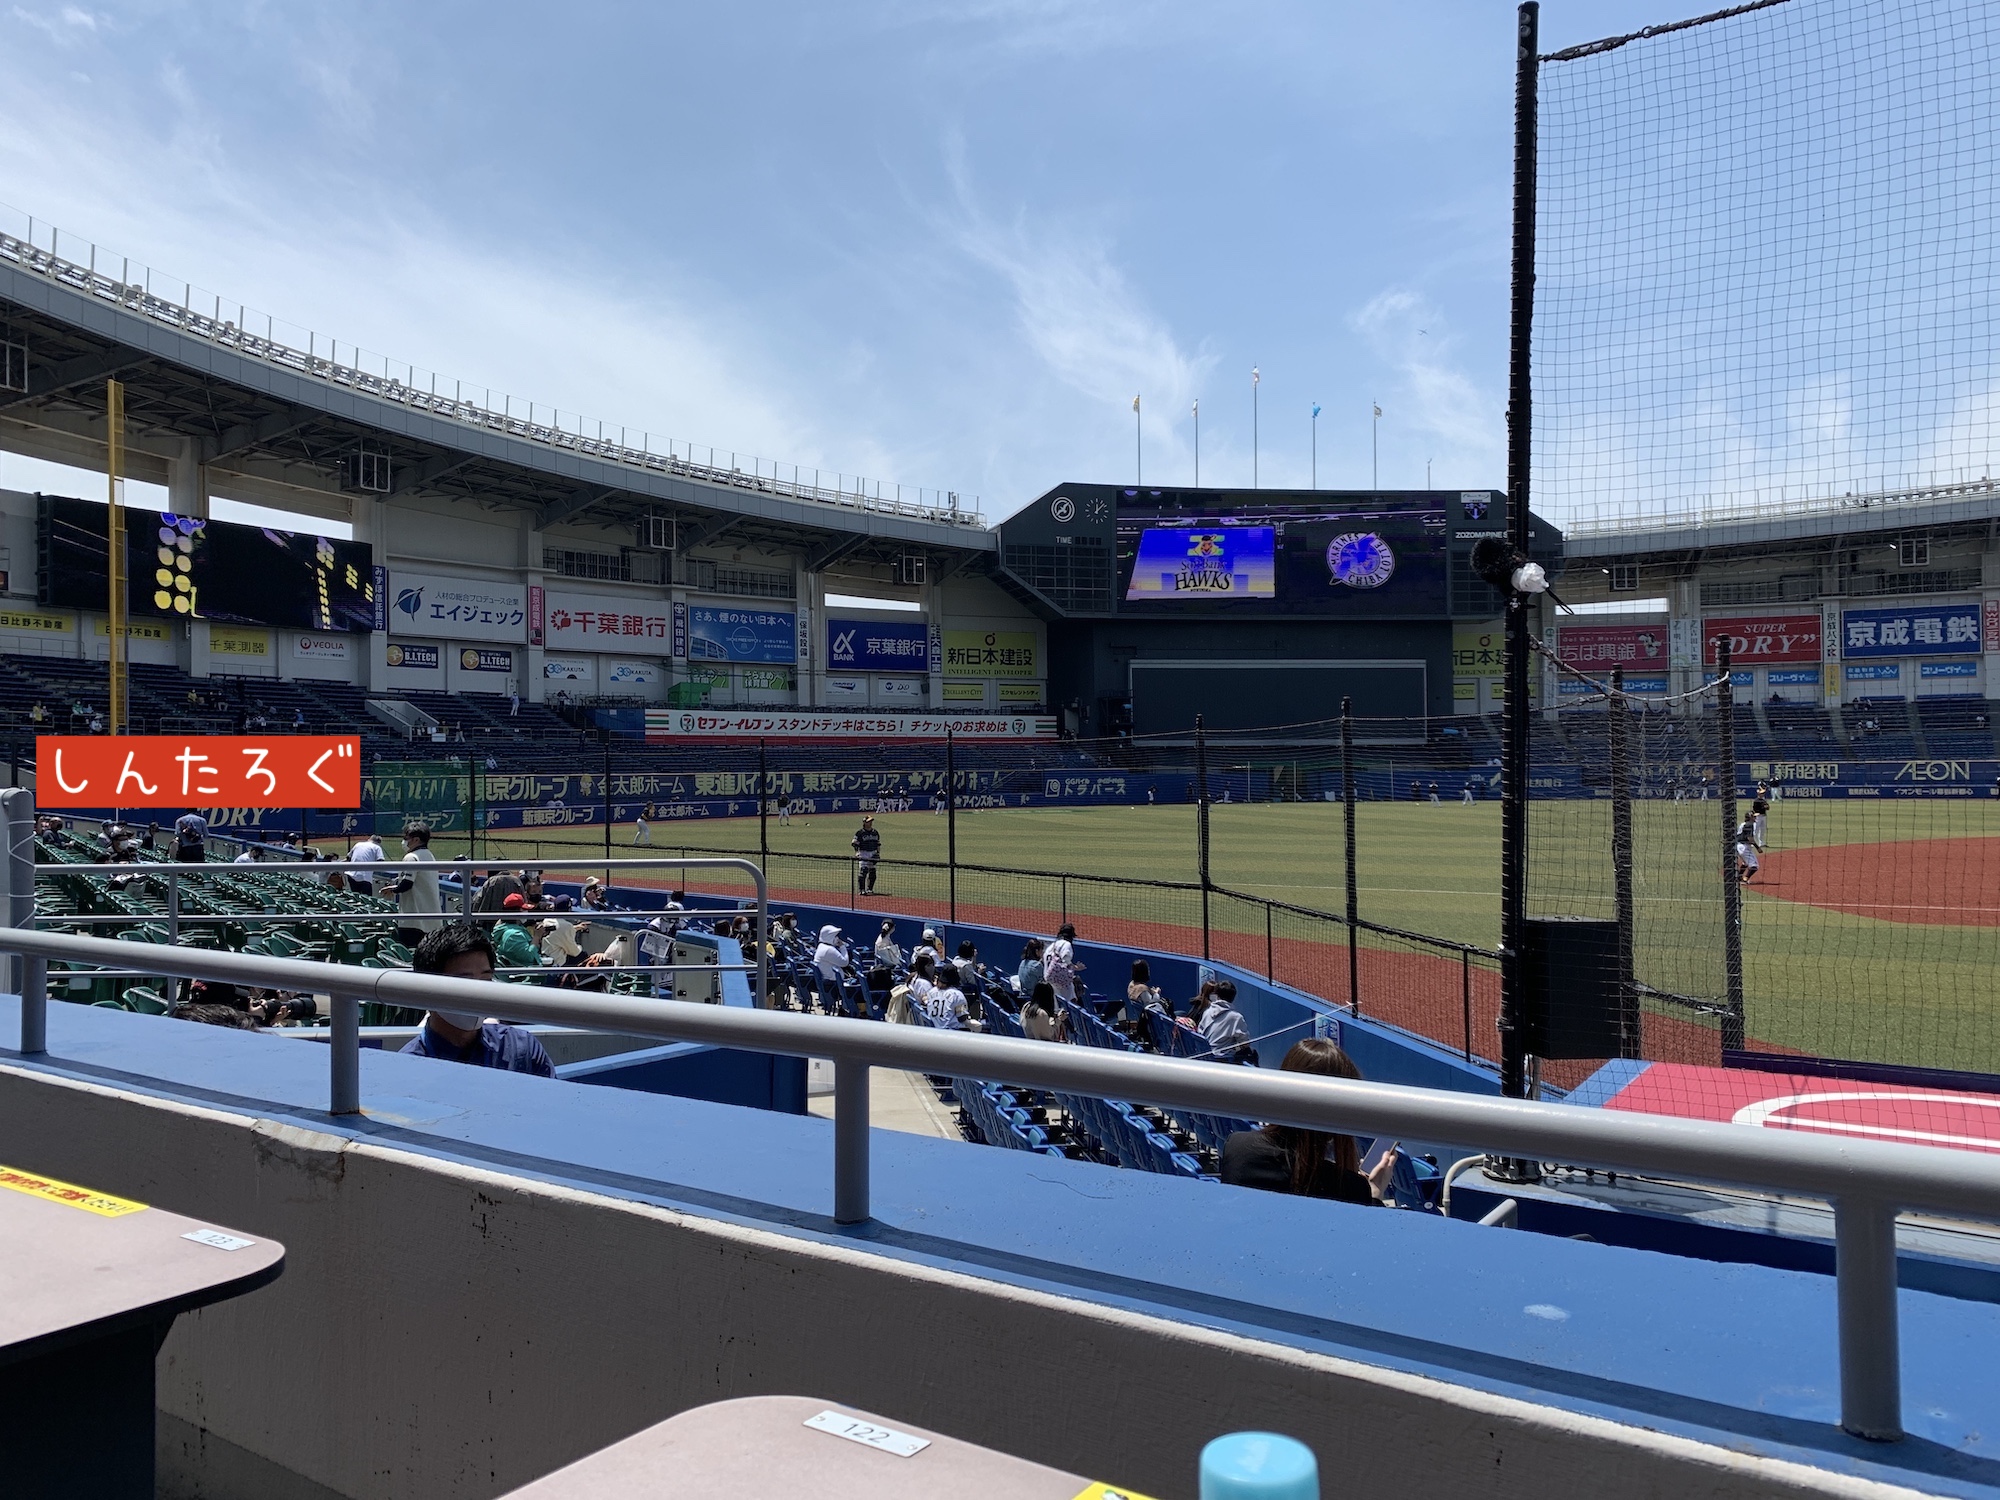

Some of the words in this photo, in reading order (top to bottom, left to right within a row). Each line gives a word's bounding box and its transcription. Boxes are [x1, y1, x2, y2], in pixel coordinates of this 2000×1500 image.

[1056, 536, 1072, 545] TIME
[1174, 570, 1232, 590] HAWKS
[1348, 573, 1383, 585] CHIBA
[374, 566, 383, 630] みずほ信託銀行
[435, 591, 519, 606] 人材の総合プロデュース企業
[430, 603, 524, 626] エイジェック
[531, 587, 541, 628] 新京成電鉄
[574, 612, 665, 637] 千葉銀行
[695, 610, 791, 628] さあ、煙のない日本へ。
[1744, 623, 1787, 634] SUPER
[1826, 612, 1837, 648] 京成バス
[1847, 616, 1978, 647] 京成電鉄
[313, 641, 344, 650] VEOLIA
[866, 637, 925, 657] 京葉銀行
[1561, 643, 1636, 662] ちば興銀
[405, 652, 437, 662] B.I.TECH
[480, 655, 510, 666] B.I.TECH
[948, 648, 1033, 666] 新日本建設
[778, 719, 904, 732] スタンドデッキはこちら！
[911, 720, 1008, 733] チケットのお求めは
[1774, 763, 1839, 780] 新昭和
[456, 776, 569, 801] 新東京グループ
[596, 776, 685, 796] 金太郎ホーム
[802, 773, 901, 792] 東京インテリア
[962, 795, 1006, 807] アインズホーム
[1785, 787, 1822, 797] 新昭和
[522, 807, 594, 825] 新東京グループ
[658, 805, 709, 818] 金太郎ホーム
[931, 999, 945, 1018] 31
[203, 1234, 233, 1245] 123
[843, 1423, 890, 1444] 122
